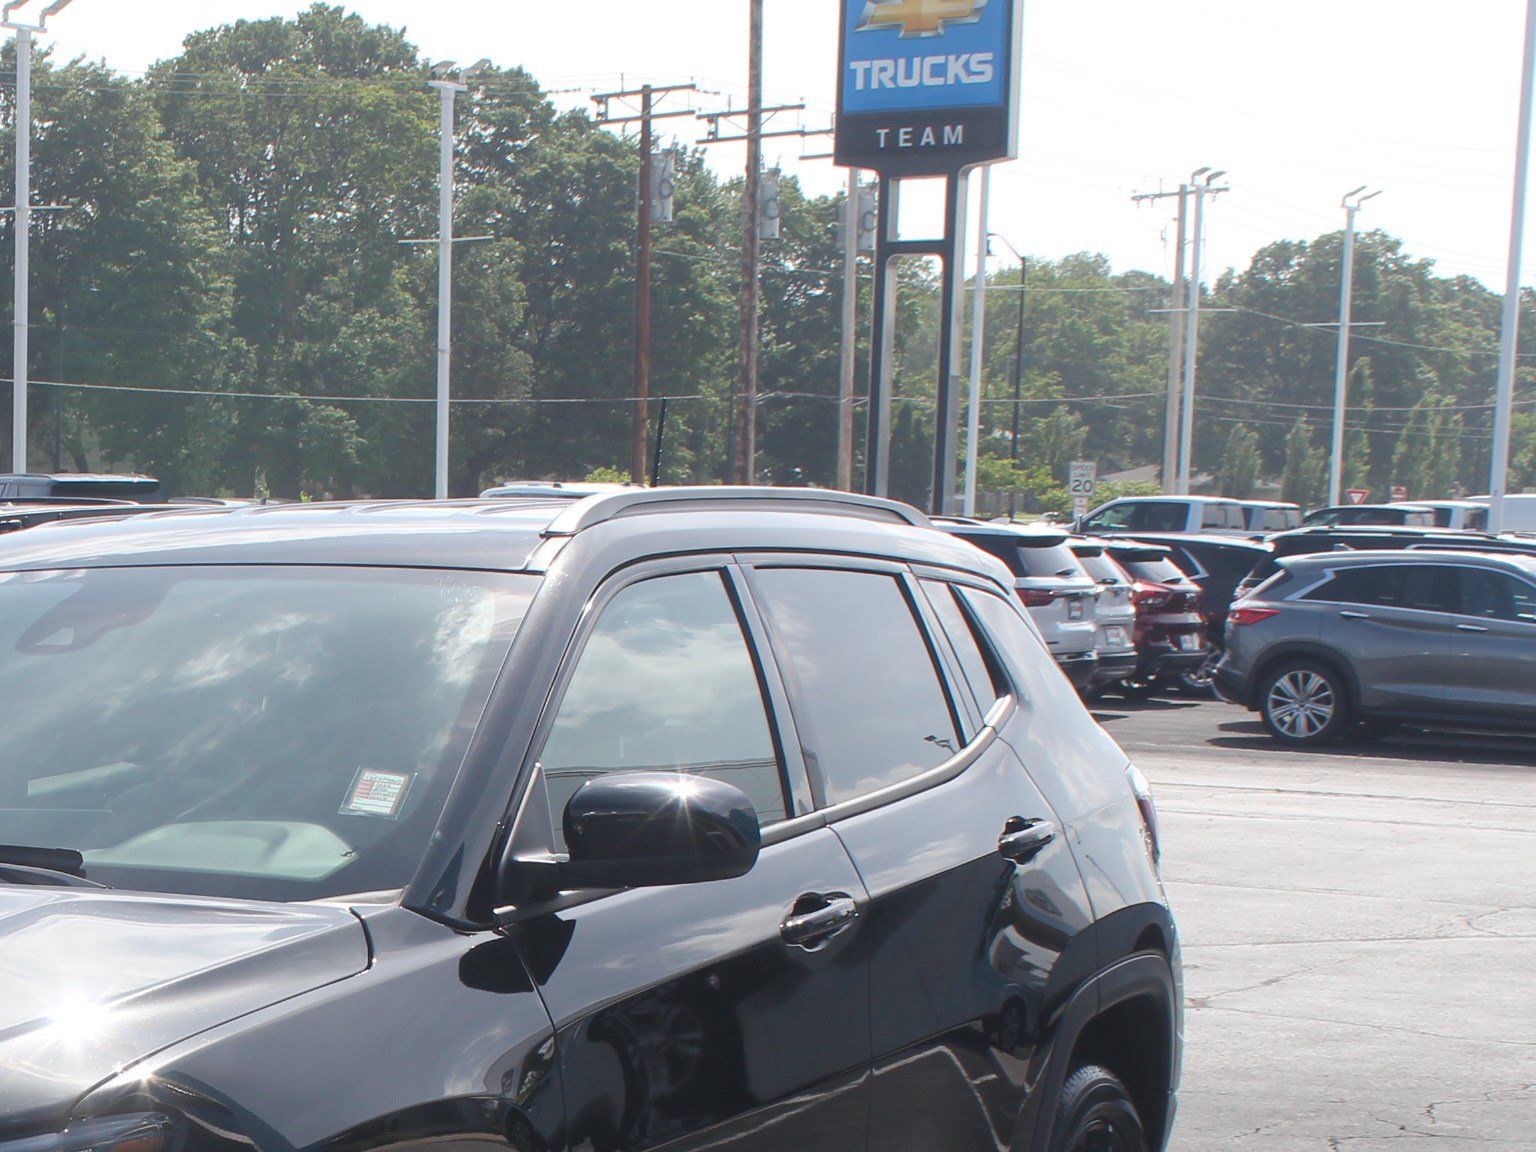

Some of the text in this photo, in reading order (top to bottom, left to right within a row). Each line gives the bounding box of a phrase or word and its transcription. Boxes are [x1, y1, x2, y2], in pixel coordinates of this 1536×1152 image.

[849, 52, 994, 90] TRUCKS
[876, 125, 964, 148] TEAM
[1072, 479, 1093, 493] 20
